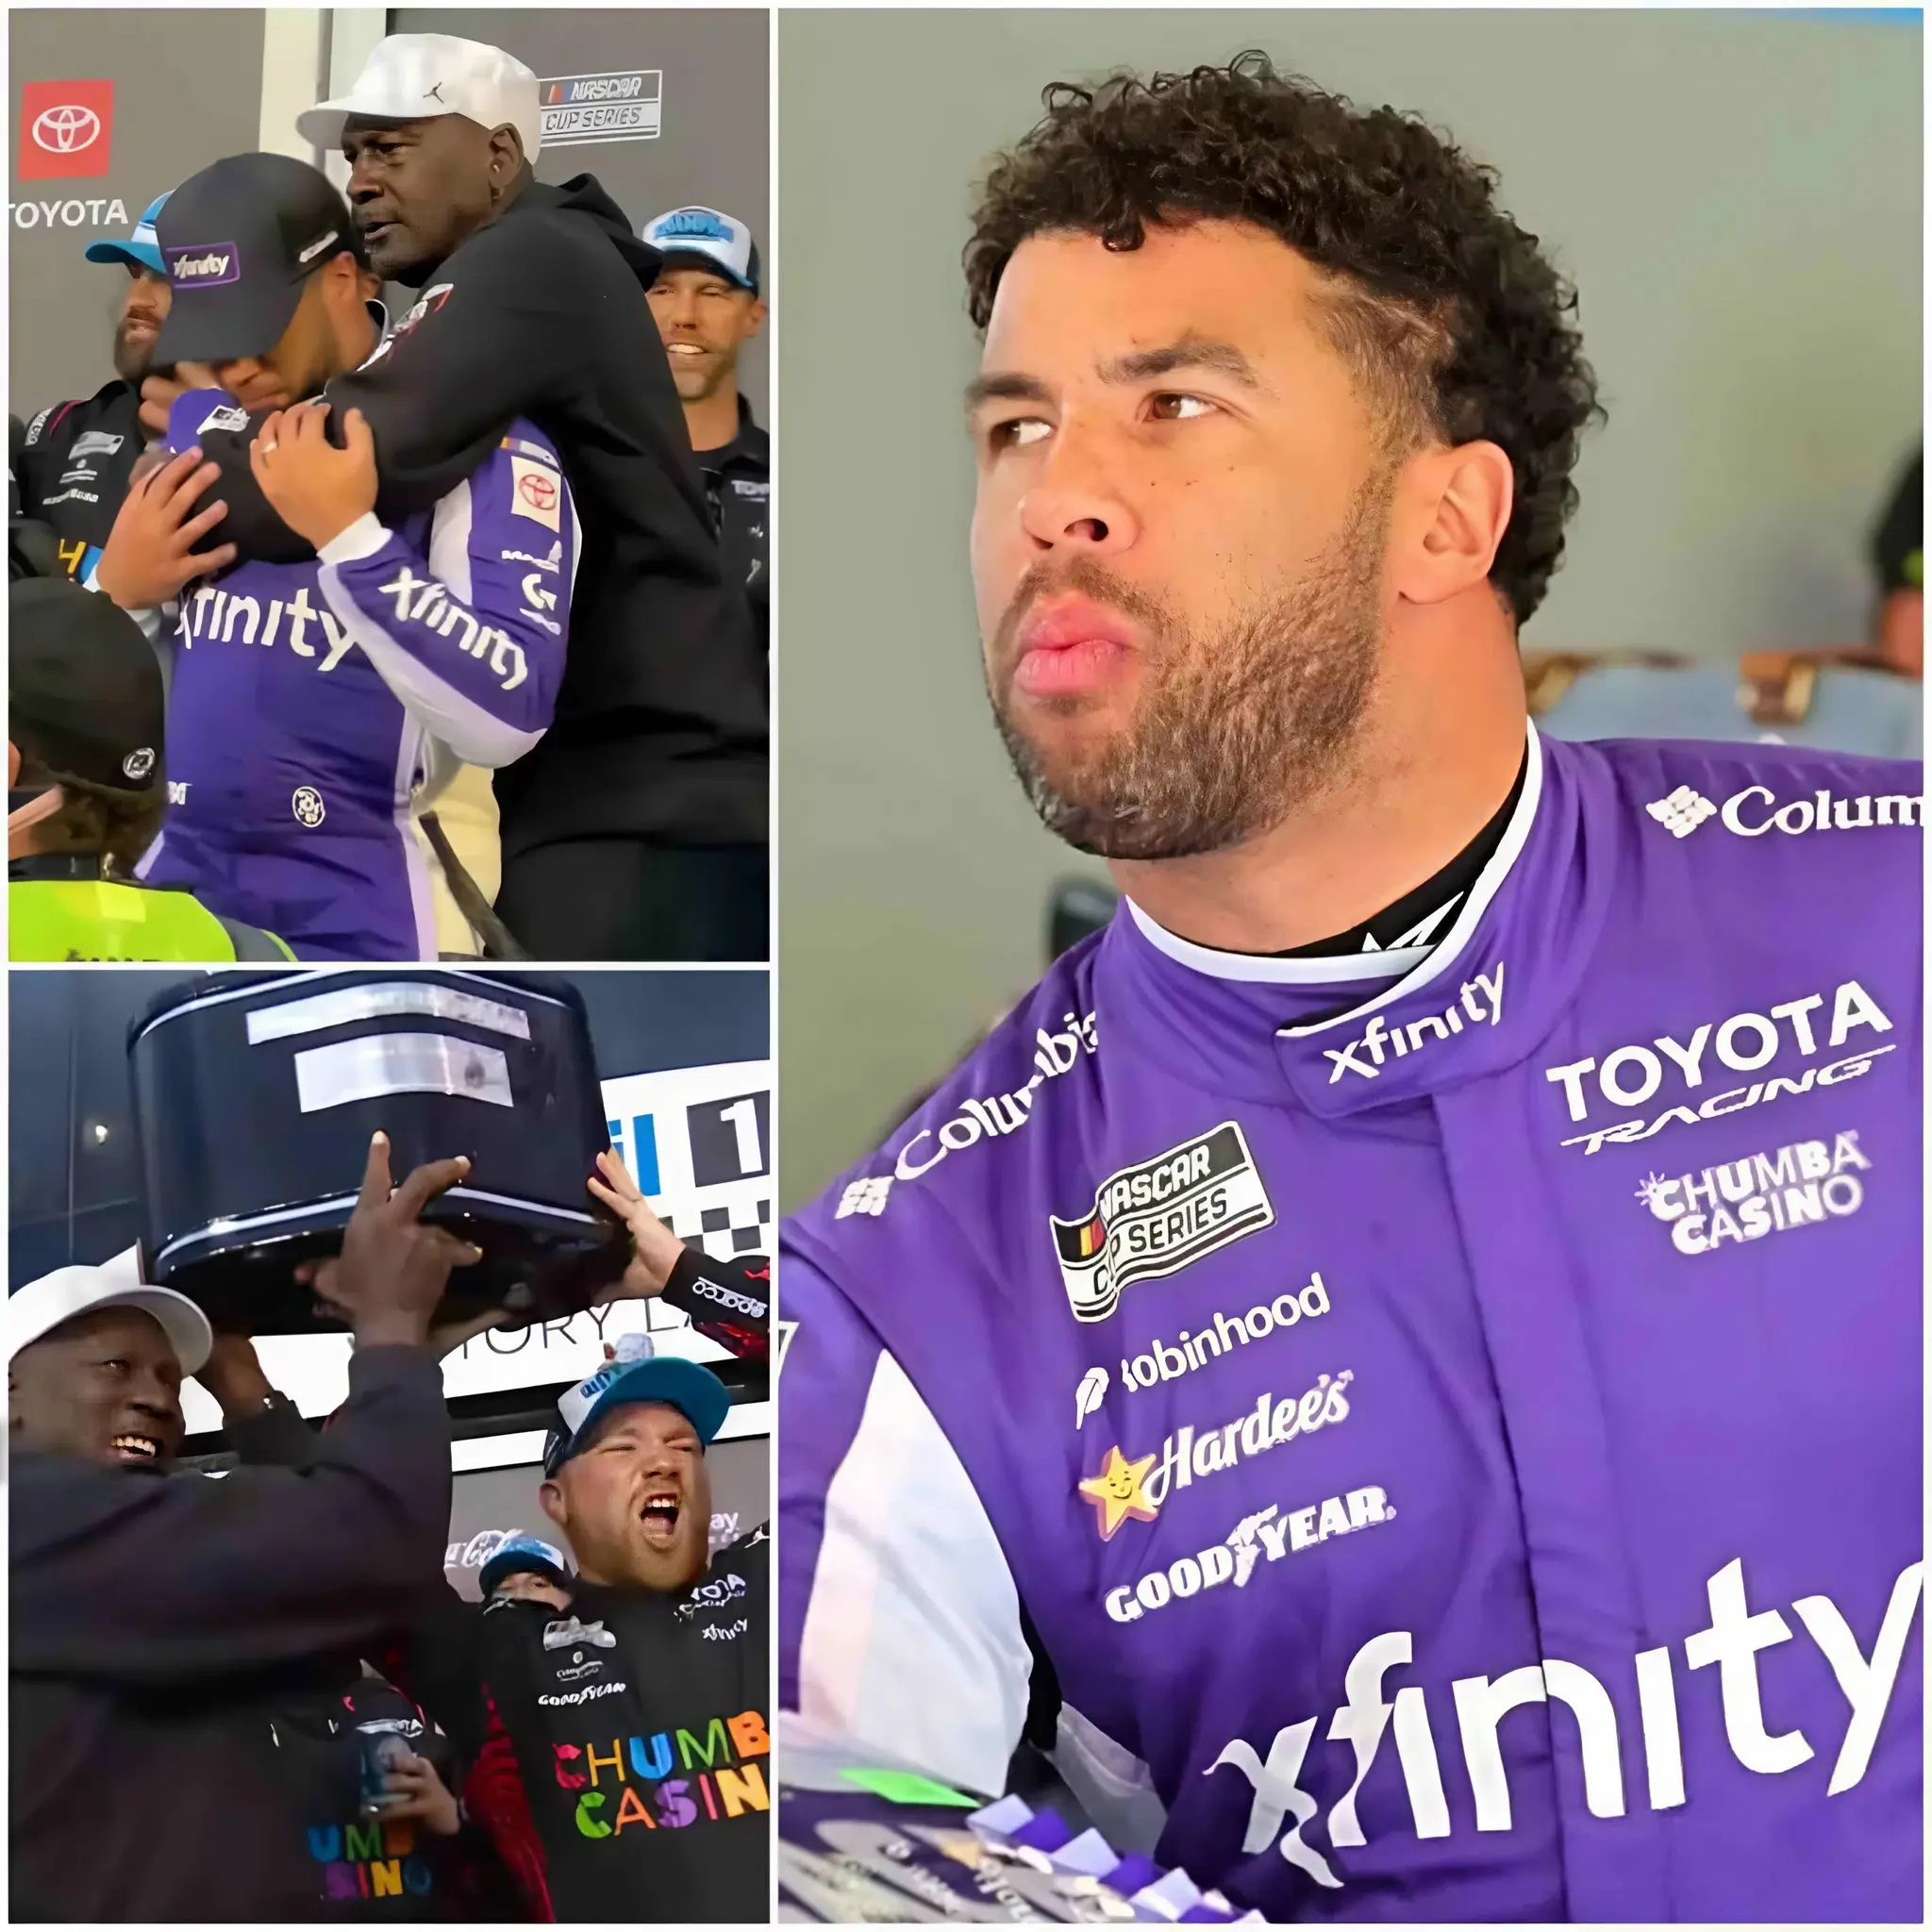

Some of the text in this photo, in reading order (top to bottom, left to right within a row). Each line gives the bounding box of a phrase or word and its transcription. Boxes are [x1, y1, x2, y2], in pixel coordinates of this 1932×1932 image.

[545, 107, 642, 130] CUP SERIES
[378, 566, 528, 691] xfinity
[1323, 960, 1505, 1084] xfinity
[1545, 979, 1893, 1122] TOYOTA
[720, 1098, 763, 1174] 1
[1560, 1043, 1897, 1156] RACING
[1128, 1188, 1227, 1253] SERIES
[1635, 1129, 1873, 1222] CHUMBA
[1671, 1174, 1864, 1255] CASINO
[1140, 1369, 1355, 1508] Hardee's
[1105, 1485, 1388, 1623] GOODYEAR
[1203, 1557, 1924, 1888] xfinity
